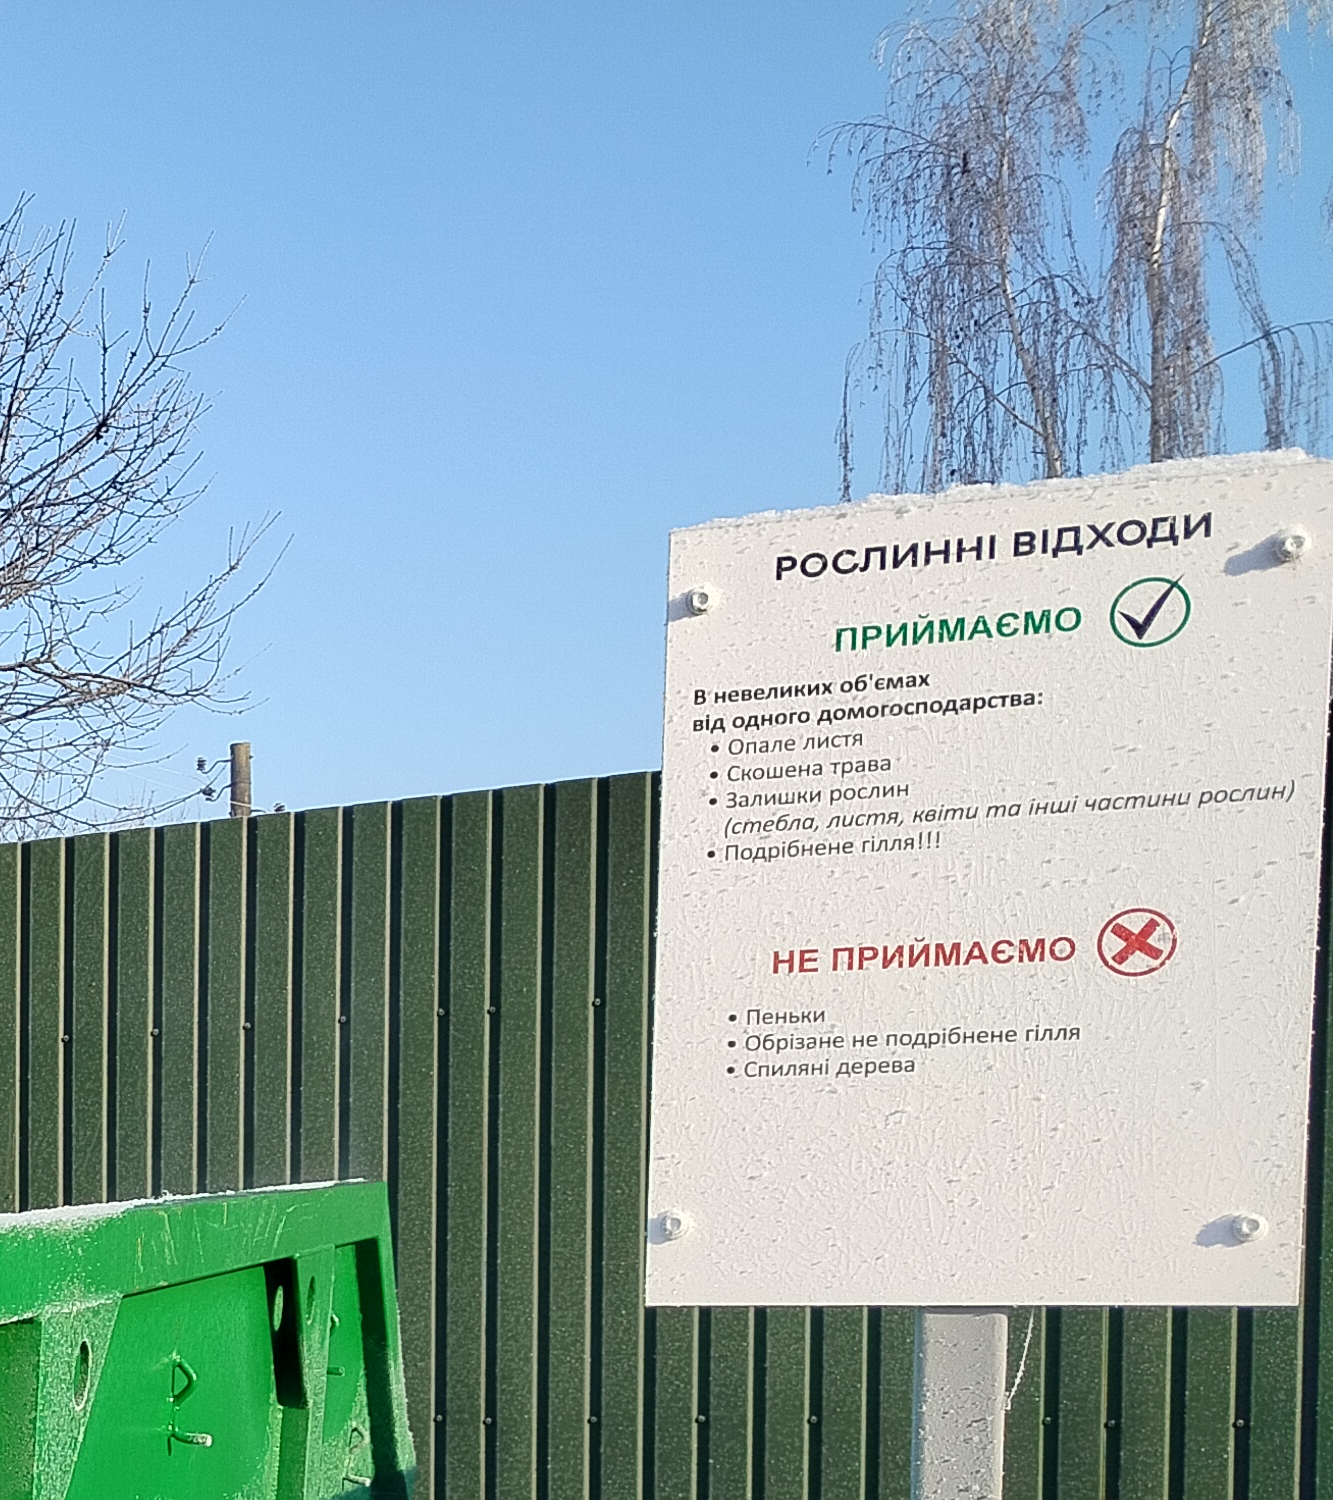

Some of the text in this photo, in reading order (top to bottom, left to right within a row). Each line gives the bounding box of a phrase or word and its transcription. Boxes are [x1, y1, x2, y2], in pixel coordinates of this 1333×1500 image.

[775, 511, 1213, 581] РОСЛИННІ ВІДХОДИ
[835, 607, 1082, 653] ПРИЙМАЄМО
[694, 673, 930, 706] В невеликих об'ємах
[692, 692, 1044, 734] від одного домогосподарства:
[728, 733, 863, 755] Опале листя
[727, 757, 892, 782] Скошена трава
[724, 779, 1295, 838] (стебла, листя, квіти та інші частини рослин)
[725, 784, 910, 809] Залишки рослин
[725, 831, 940, 863] Подрібнене гілля!!!
[772, 936, 1076, 974] НЕ ПРИЙМАЄМО
[746, 1008, 826, 1026] Пеньки
[745, 1024, 1081, 1053] Обрізане не подрібнене гілля
[744, 1057, 916, 1079] Спиляні дерева
